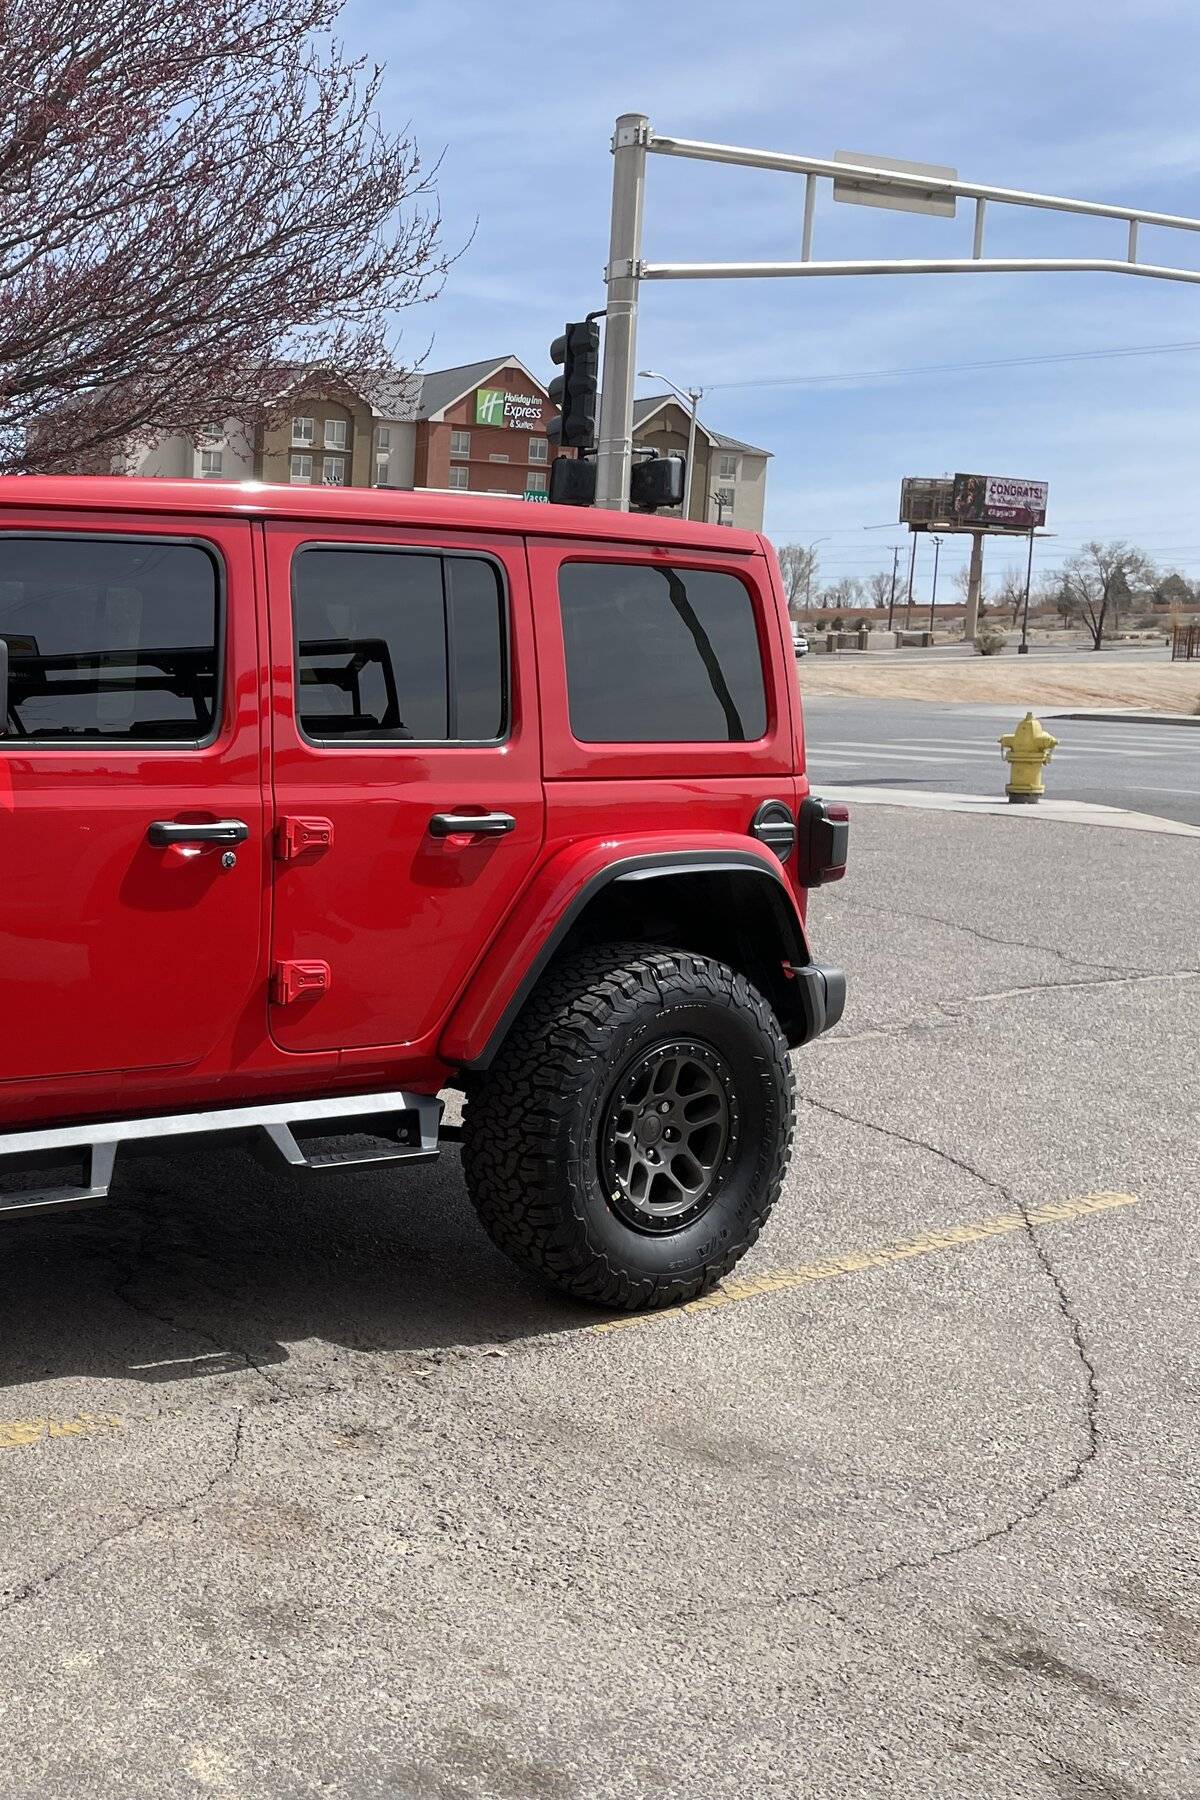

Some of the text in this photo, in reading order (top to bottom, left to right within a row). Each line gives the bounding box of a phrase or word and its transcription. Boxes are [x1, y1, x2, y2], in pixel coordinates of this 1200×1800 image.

[505, 392, 543, 406] Holiday Inn
[504, 403, 542, 419] Express
[509, 419, 534, 430] & Suites
[523, 492, 551, 504] Vassa
[990, 484, 1043, 499] CONGRATS!
